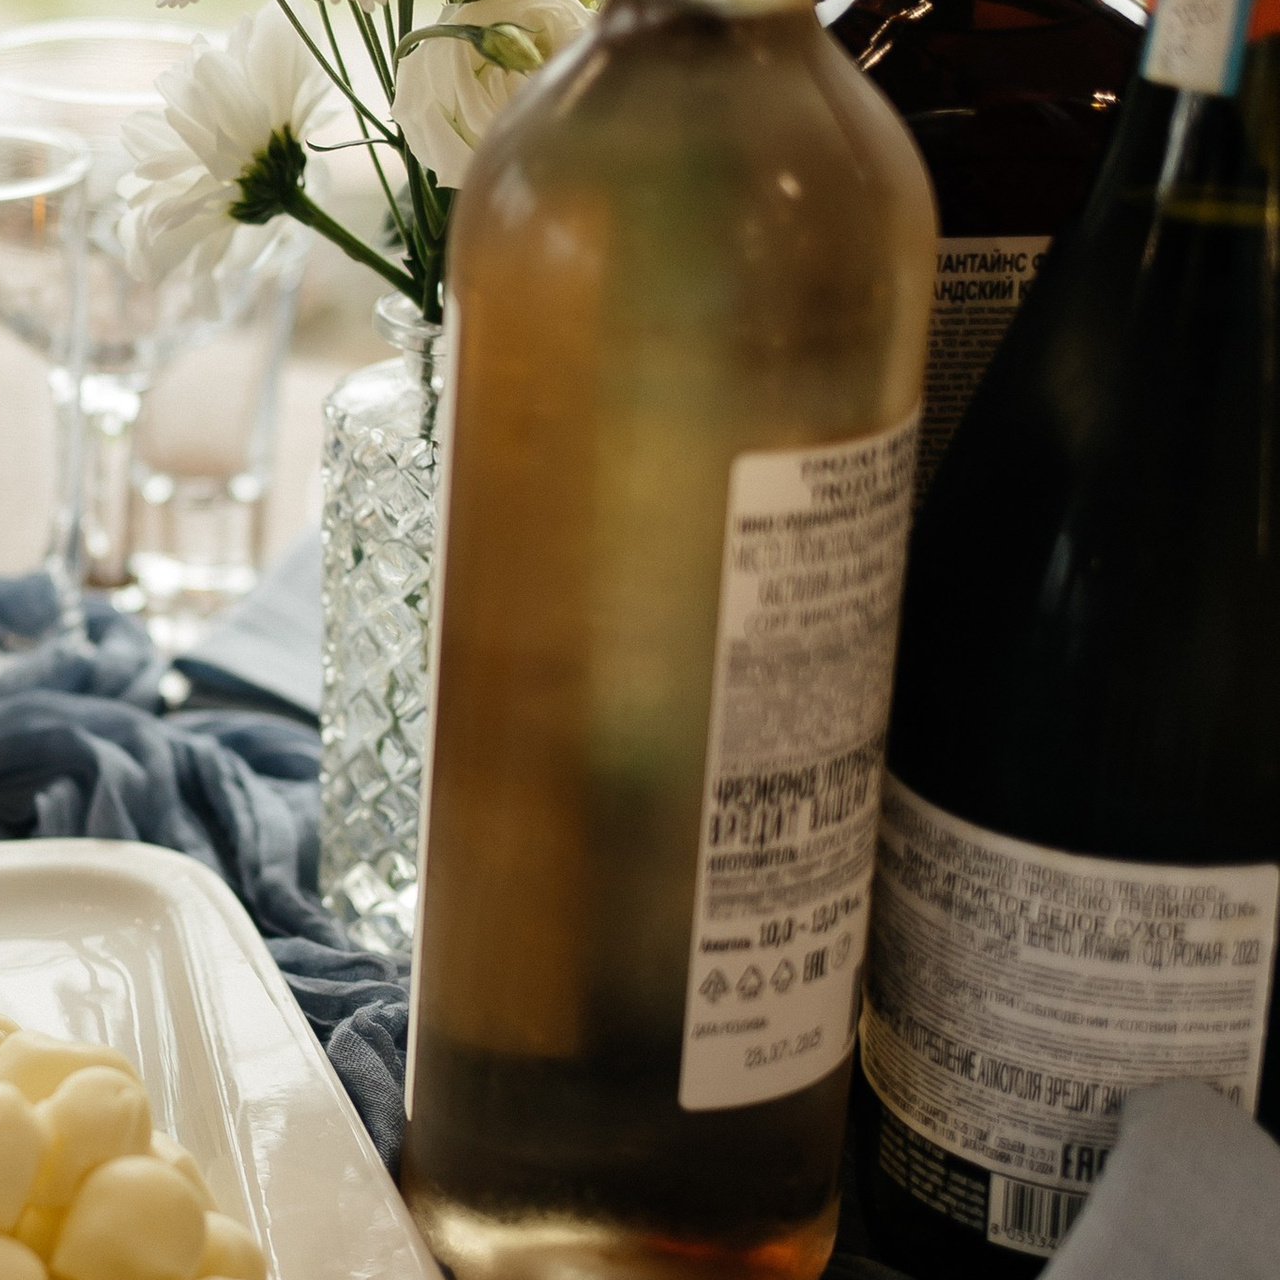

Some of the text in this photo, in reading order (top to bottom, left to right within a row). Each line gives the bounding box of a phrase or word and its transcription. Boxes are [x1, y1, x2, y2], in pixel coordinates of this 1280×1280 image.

[942, 870, 1031, 915] ИГРИСТОЕ
[1037, 902, 1106, 934] БЕЛОЕ
[1113, 918, 1186, 941] СУХОЕ
[1044, 1074, 1100, 1114] ВРЕДИТ
